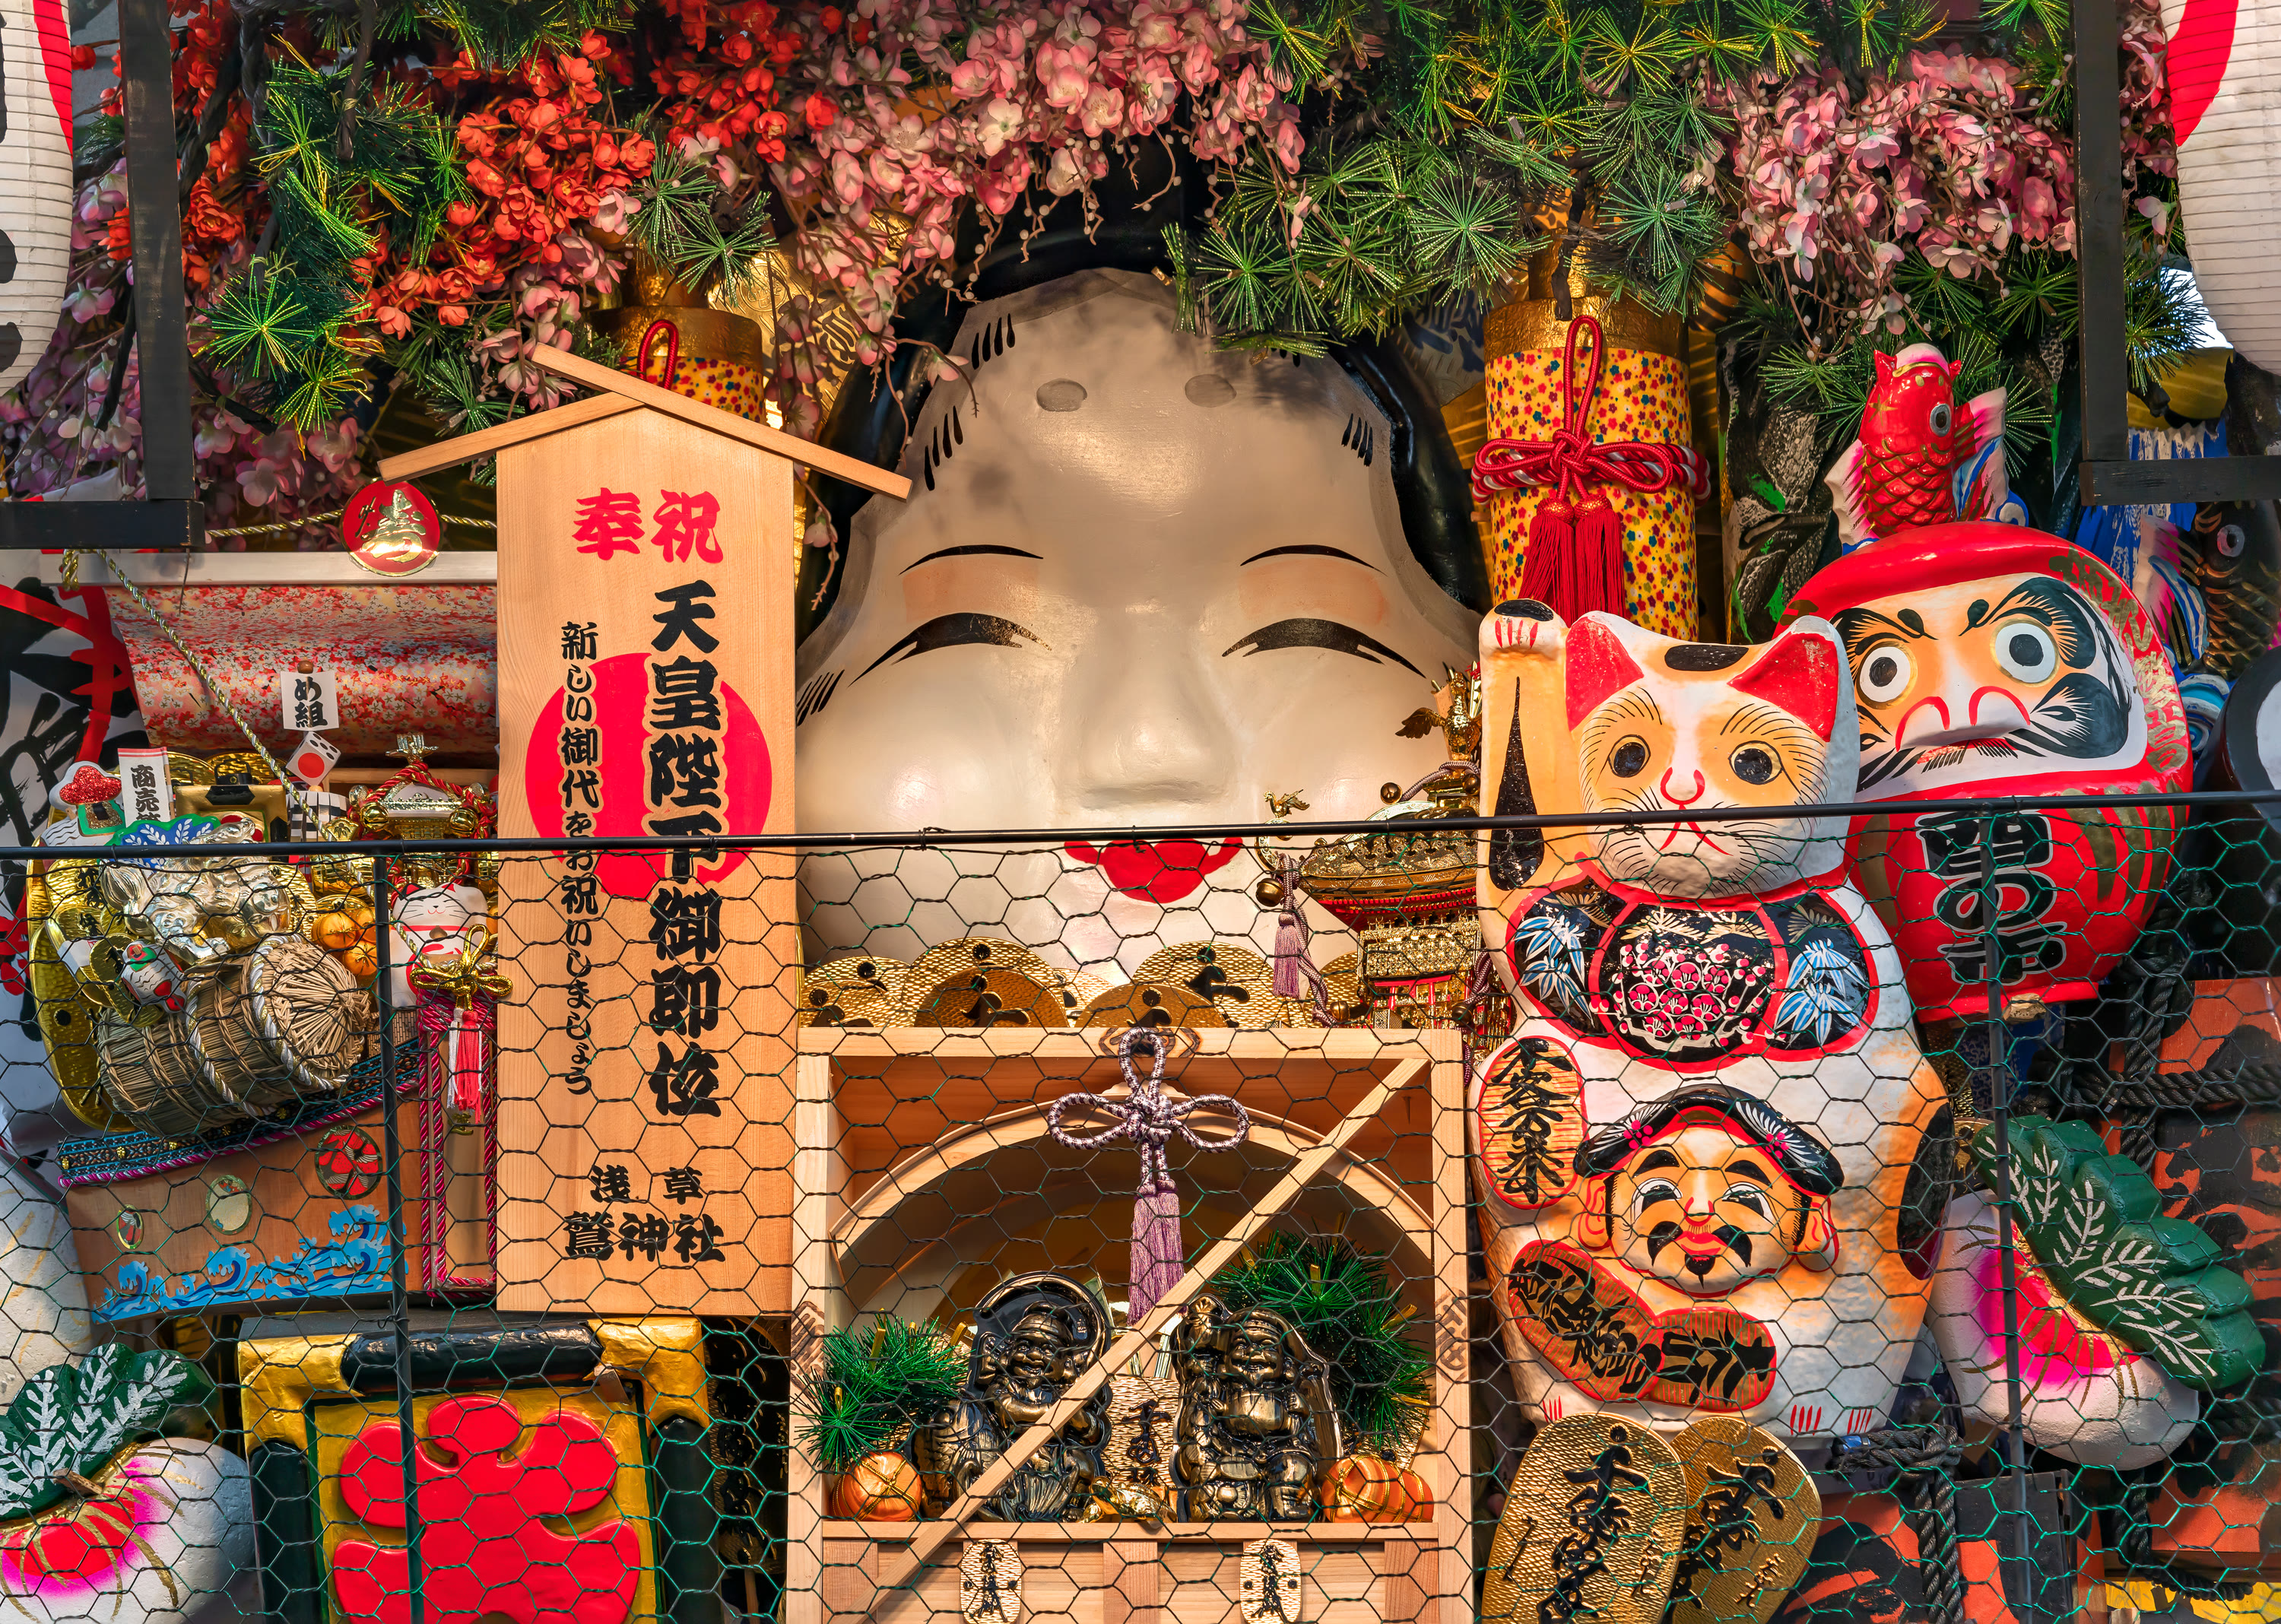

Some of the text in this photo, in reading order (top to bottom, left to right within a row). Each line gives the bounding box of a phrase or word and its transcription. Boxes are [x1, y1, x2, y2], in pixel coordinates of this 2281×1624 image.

[572, 487, 724, 563] 奉祝
[293, 676, 328, 728] め組
[560, 621, 599, 1095] 新しい御代をお祝いしましょう
[648, 579, 723, 1118] 天皇陛下御即位
[563, 1210, 726, 1264] 鷲神社
